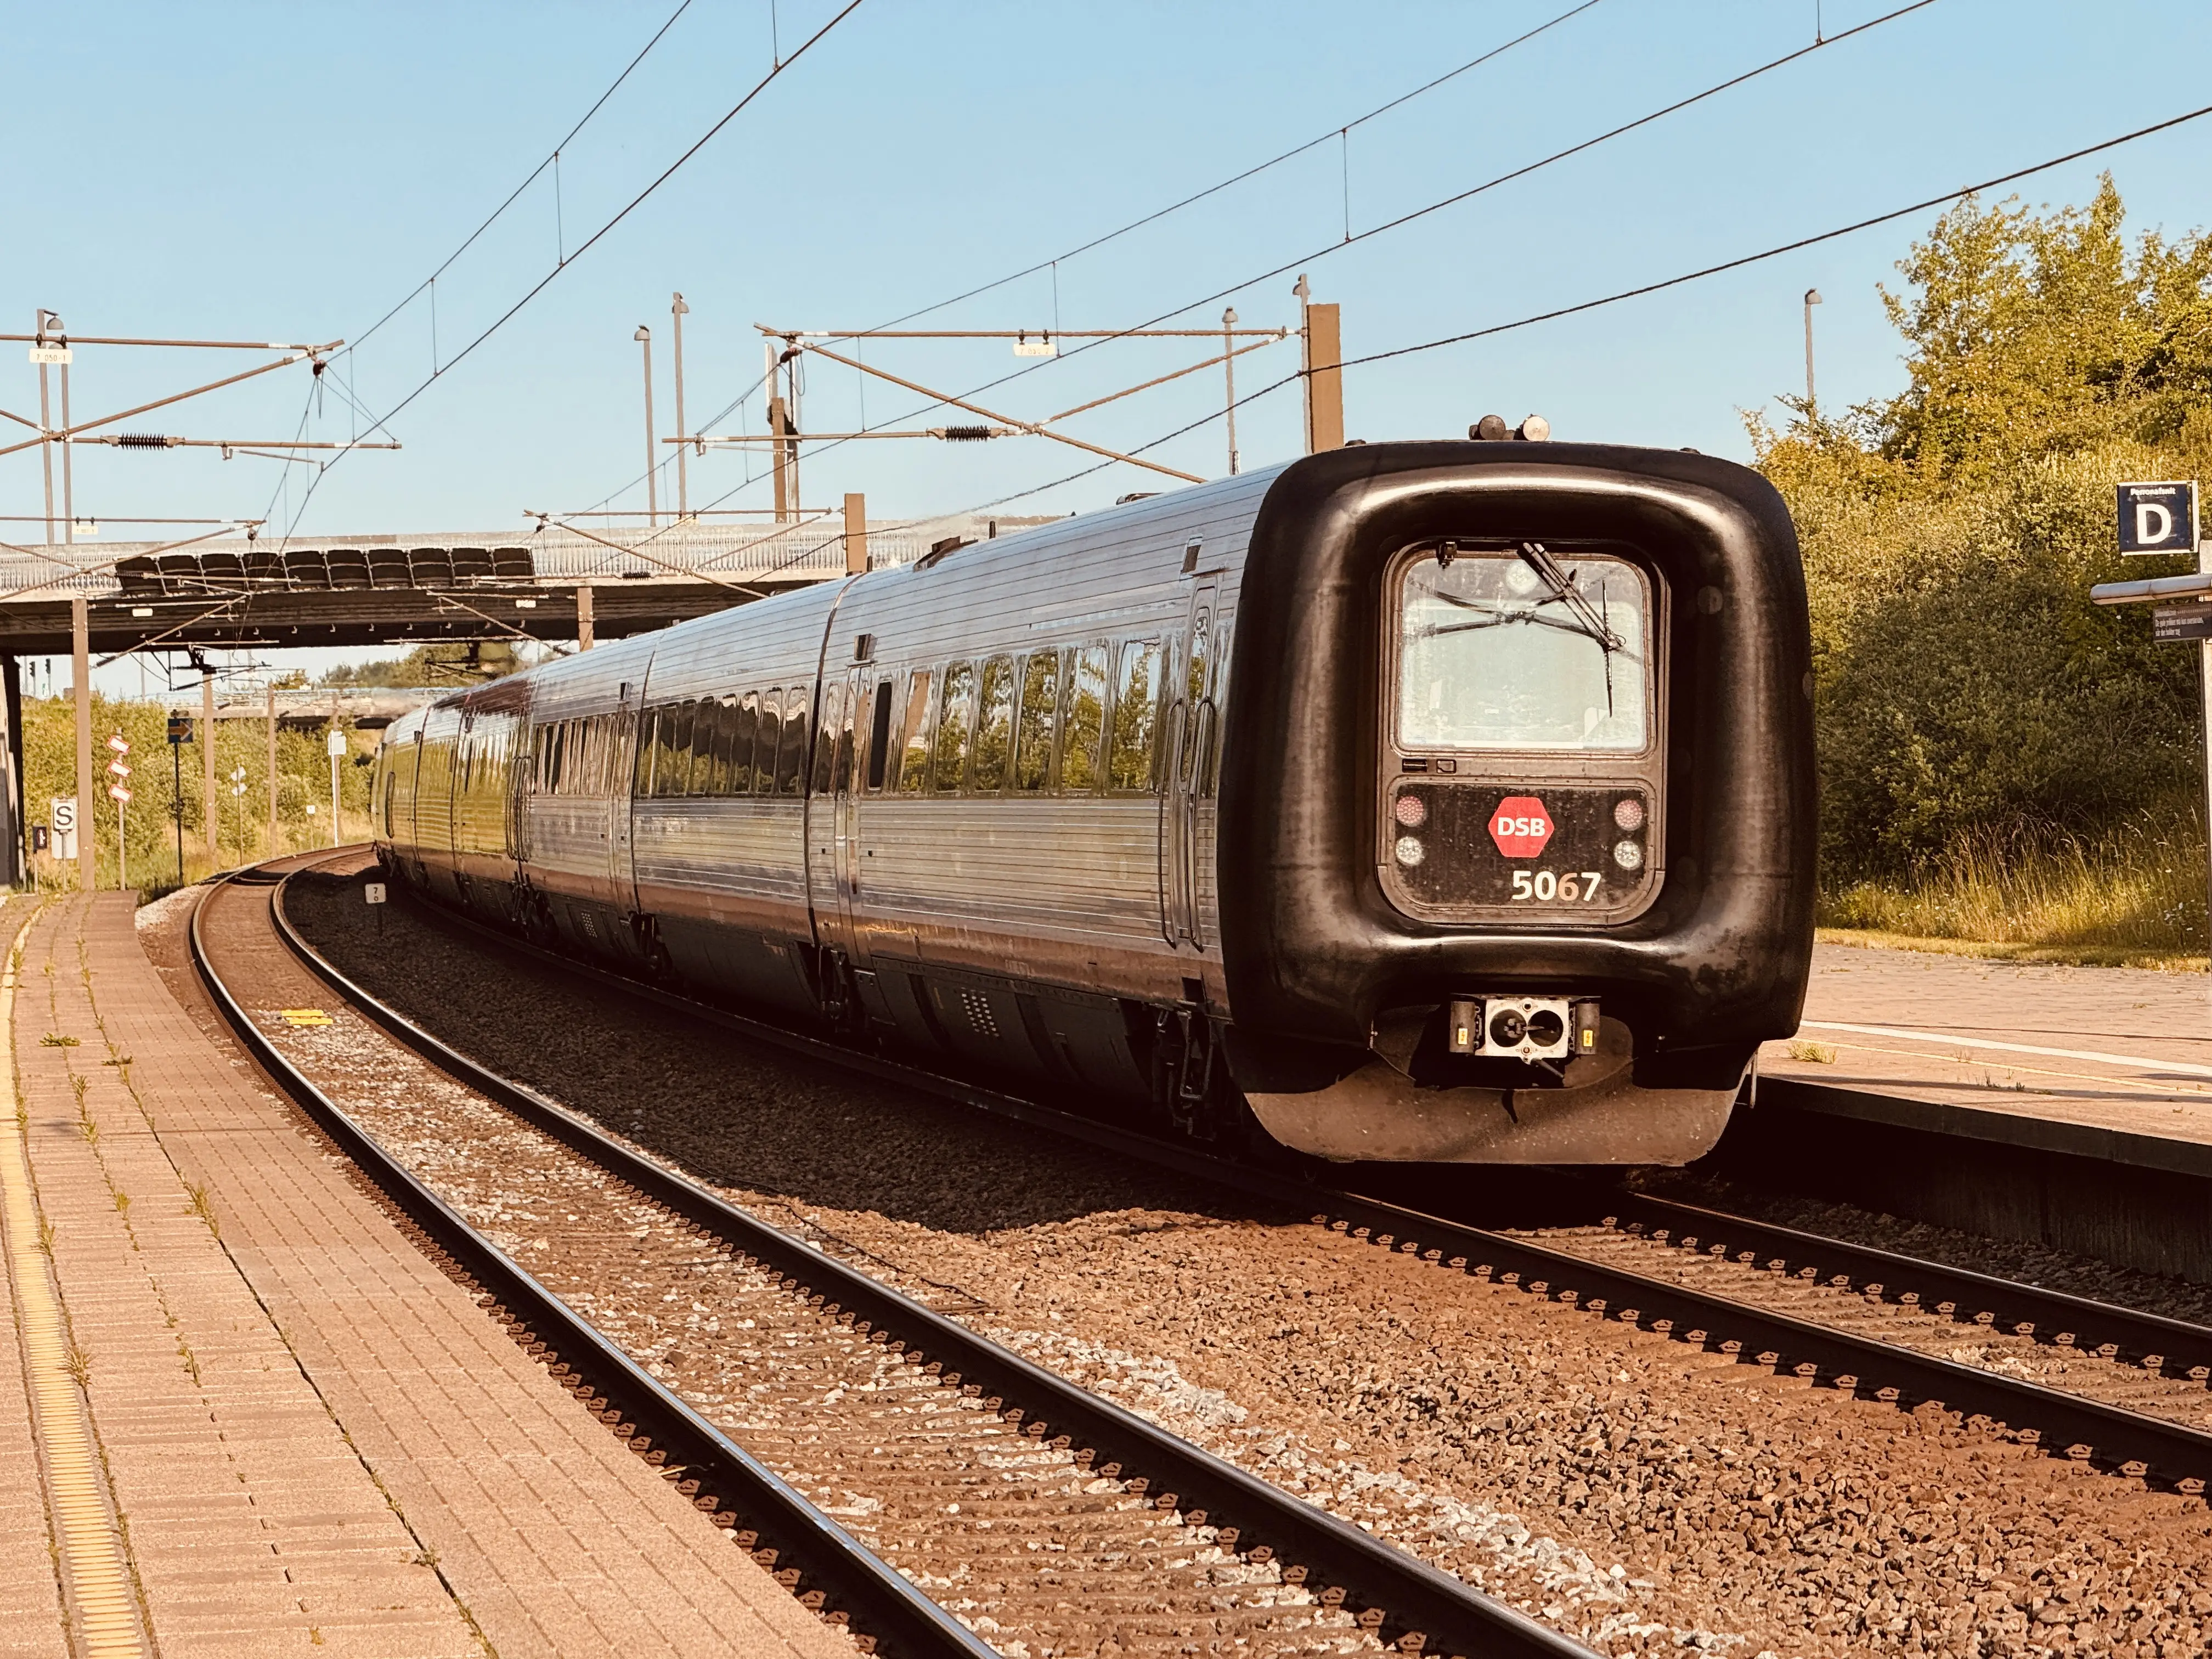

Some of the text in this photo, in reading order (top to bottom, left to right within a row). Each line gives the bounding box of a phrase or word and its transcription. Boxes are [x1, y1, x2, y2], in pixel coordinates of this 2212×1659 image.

[2136, 504, 2171, 544] D
[56, 806, 73, 826] S
[1498, 817, 1545, 837] DSB
[1512, 870, 1601, 901] 5067
